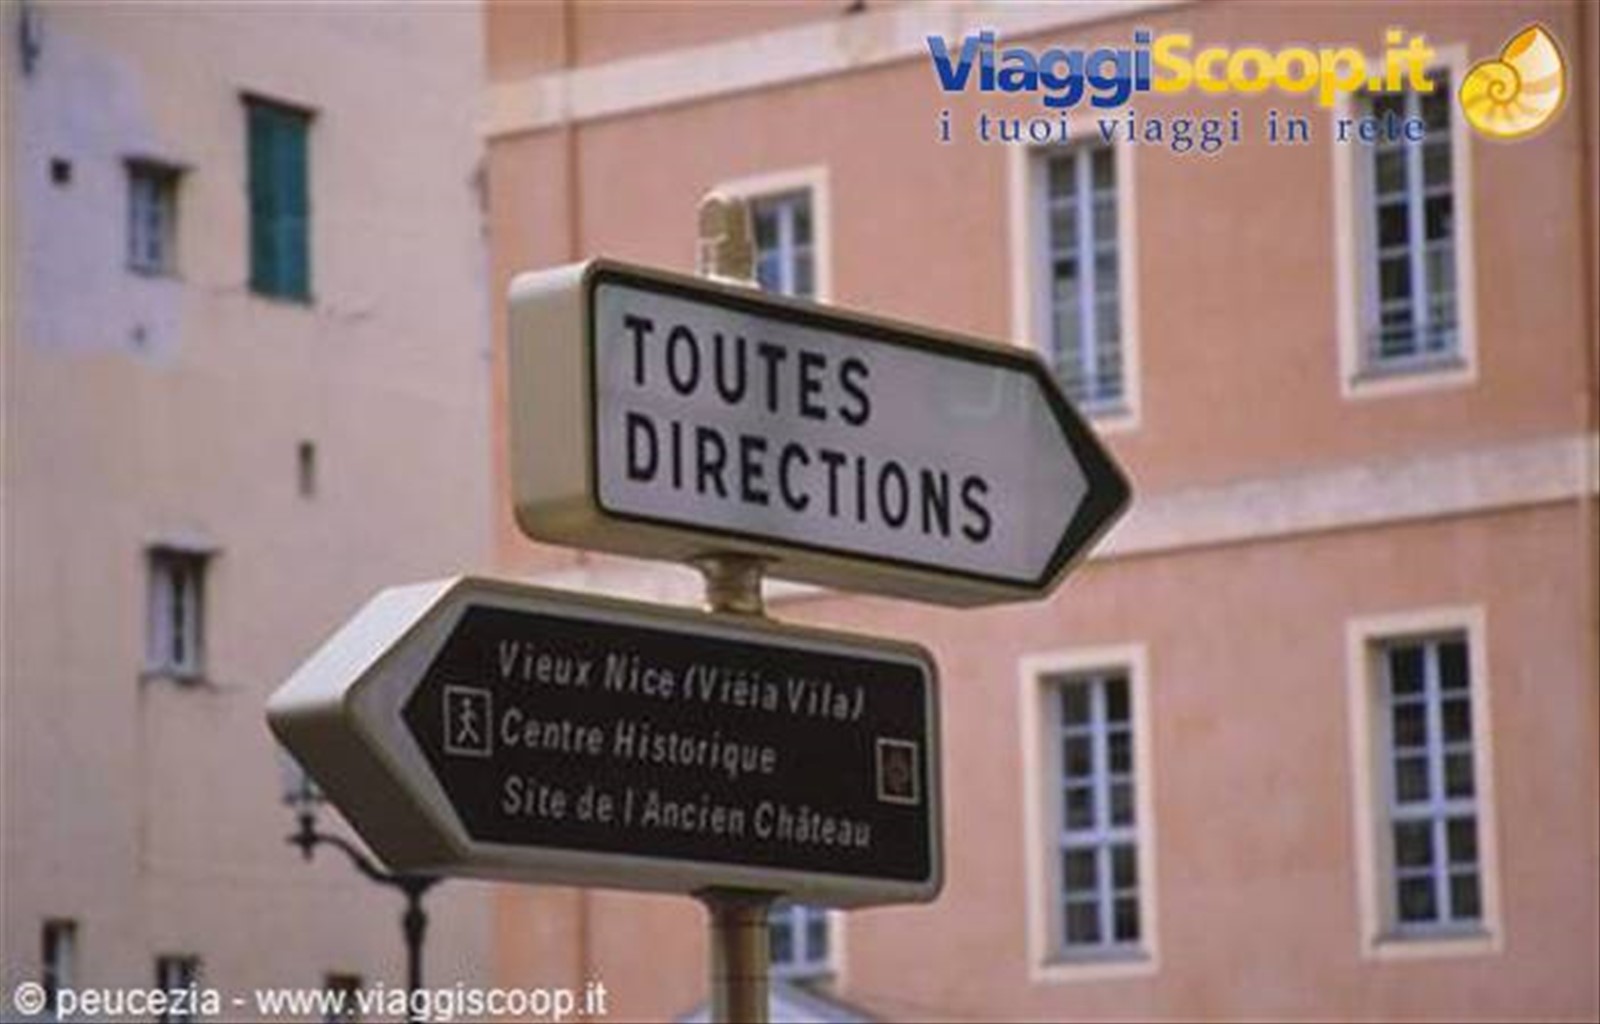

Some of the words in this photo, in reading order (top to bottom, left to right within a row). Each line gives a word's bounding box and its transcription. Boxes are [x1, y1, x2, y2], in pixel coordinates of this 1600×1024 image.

[623, 314, 871, 426] TOUTES
[625, 411, 992, 542] DIRECTIONS
[499, 640, 592, 686] Vieux
[603, 652, 676, 696] Nice
[787, 677, 865, 721] Vila)
[501, 706, 604, 754] Centre
[612, 718, 777, 779] Historique
[503, 775, 567, 819] Site
[576, 785, 614, 821] de
[753, 801, 872, 847] Château
